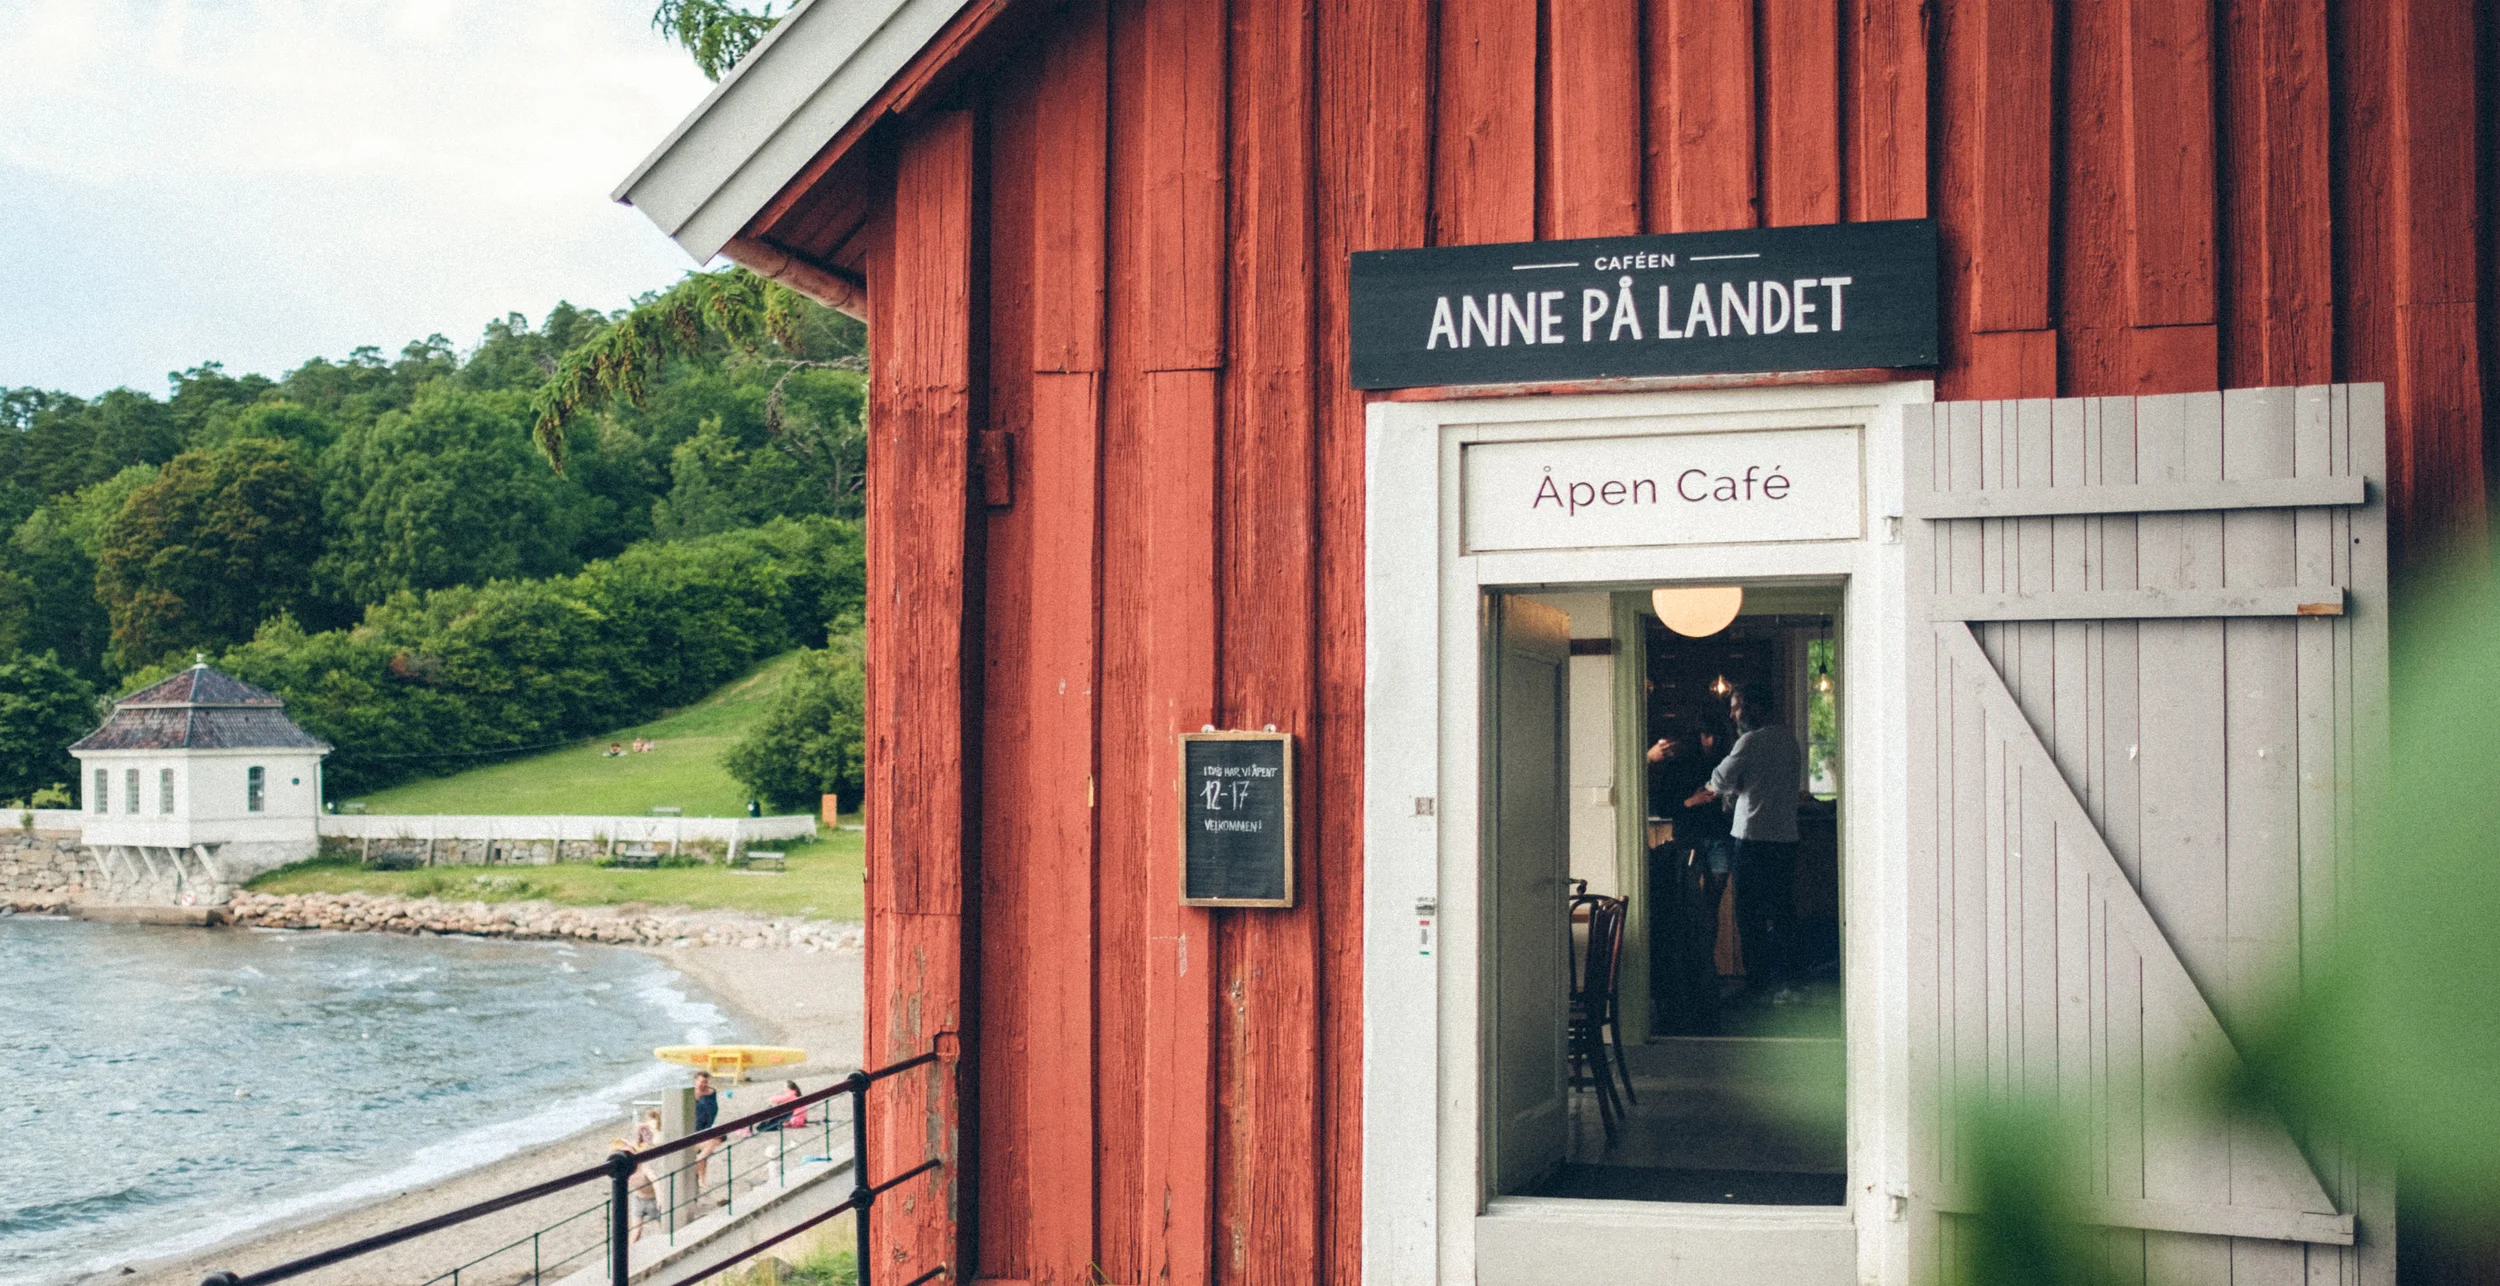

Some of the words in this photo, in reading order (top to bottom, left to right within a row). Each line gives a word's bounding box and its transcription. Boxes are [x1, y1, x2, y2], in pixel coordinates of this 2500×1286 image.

[1594, 252, 1676, 270] CAFÉEN
[1426, 290, 1565, 350] ANNE
[1581, 276, 1643, 342] PÅ
[1658, 277, 1851, 339] LANDET
[1532, 465, 1657, 516] Åpen
[1677, 465, 1791, 503] Café
[1224, 766, 1241, 778] HAR
[1241, 766, 1251, 777] VI
[1251, 764, 1278, 778] ÅPENT
[1200, 781, 1249, 810] 12-17
[1204, 820, 1262, 832] VELKOMMEN!
